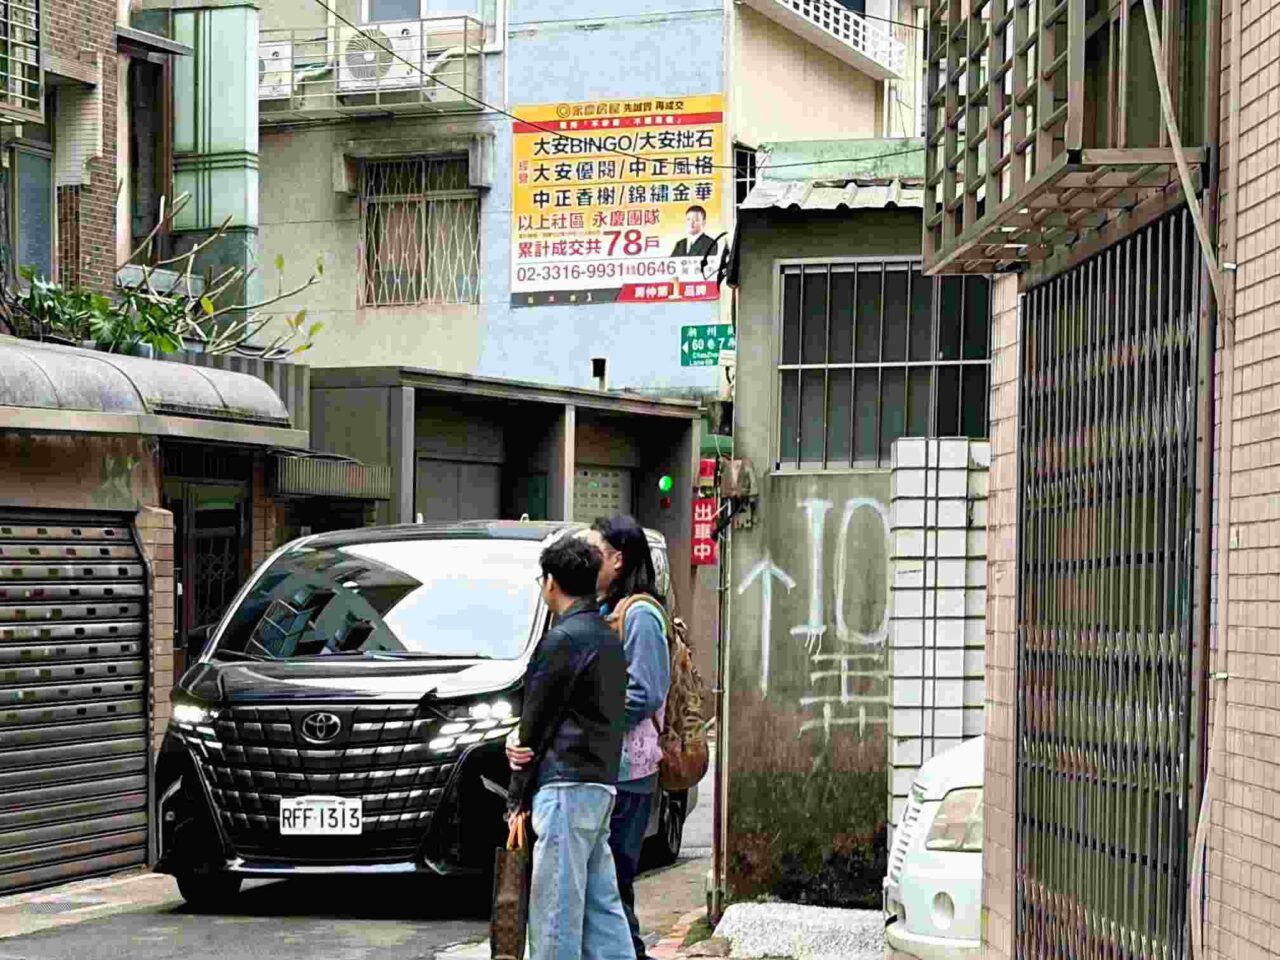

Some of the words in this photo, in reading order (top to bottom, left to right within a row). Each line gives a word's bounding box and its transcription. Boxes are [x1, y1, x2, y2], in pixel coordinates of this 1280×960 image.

[517, 212, 585, 231] 以上社區
[592, 209, 660, 229] 永慶團隊
[694, 503, 712, 560] 出車中
